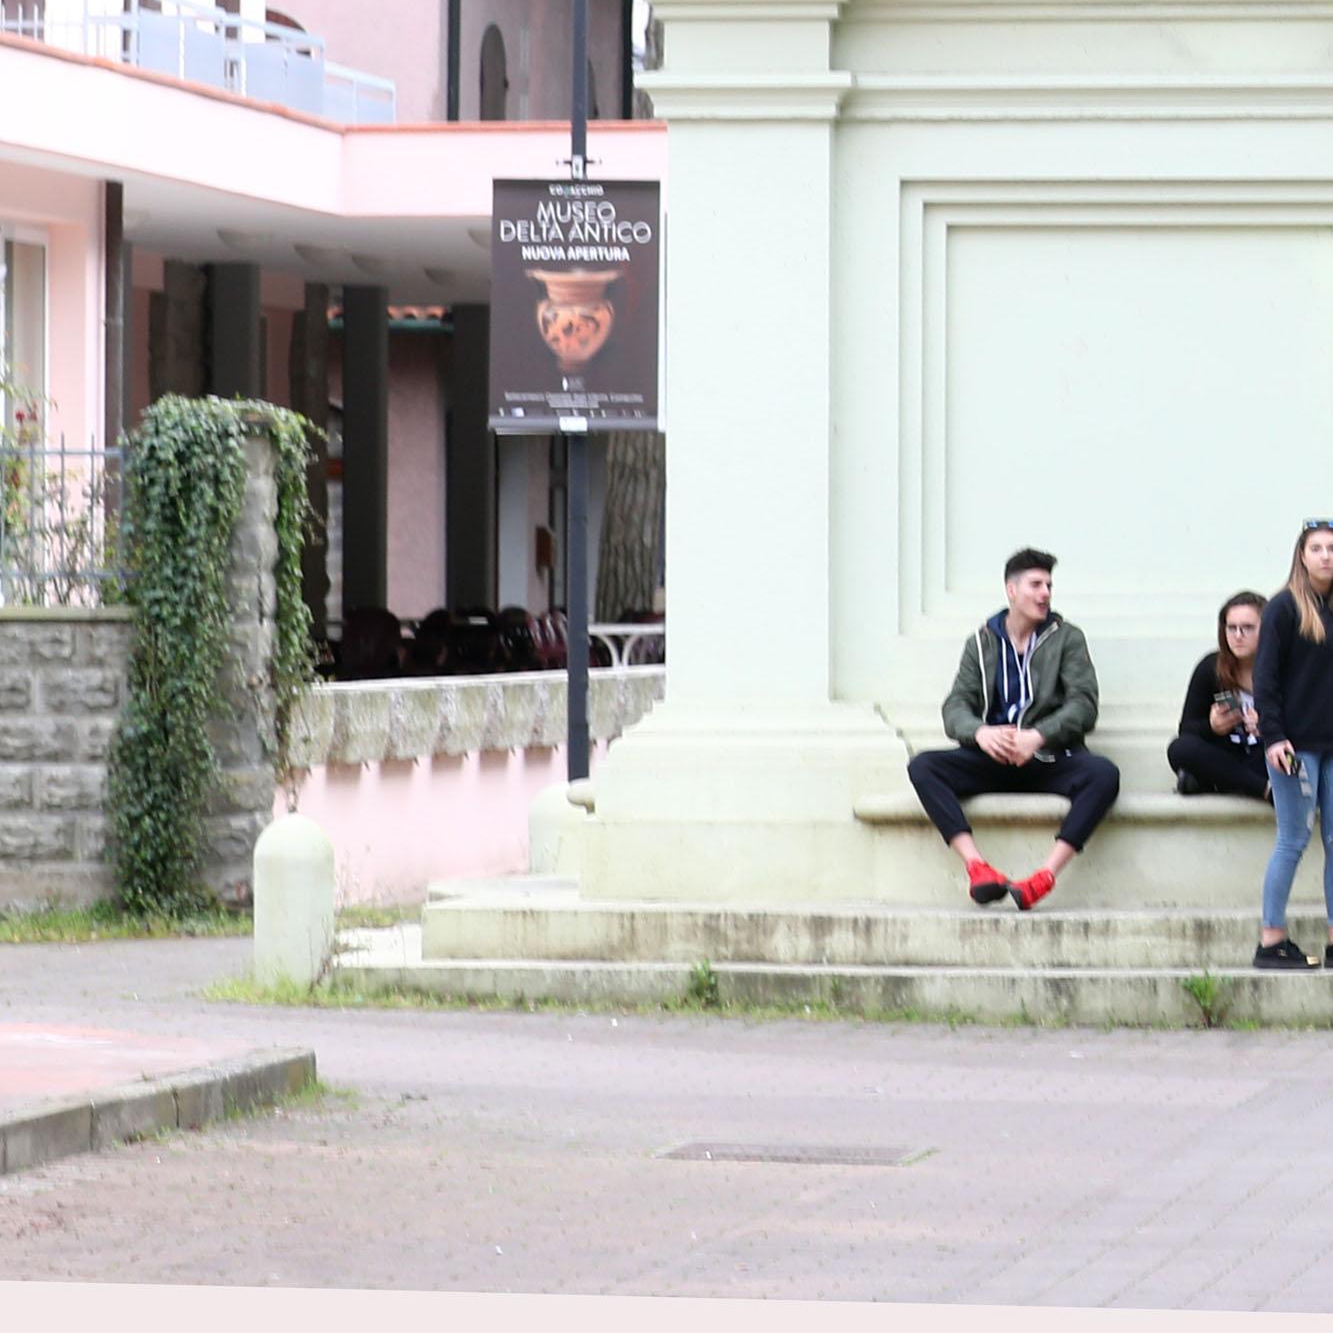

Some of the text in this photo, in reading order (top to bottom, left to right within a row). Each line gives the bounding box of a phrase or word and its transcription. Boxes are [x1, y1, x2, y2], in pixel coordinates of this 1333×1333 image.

[537, 200, 616, 224] MUSEO
[500, 219, 652, 244] DELTA ANTICO
[522, 246, 630, 262] NUOVA APERTURA
